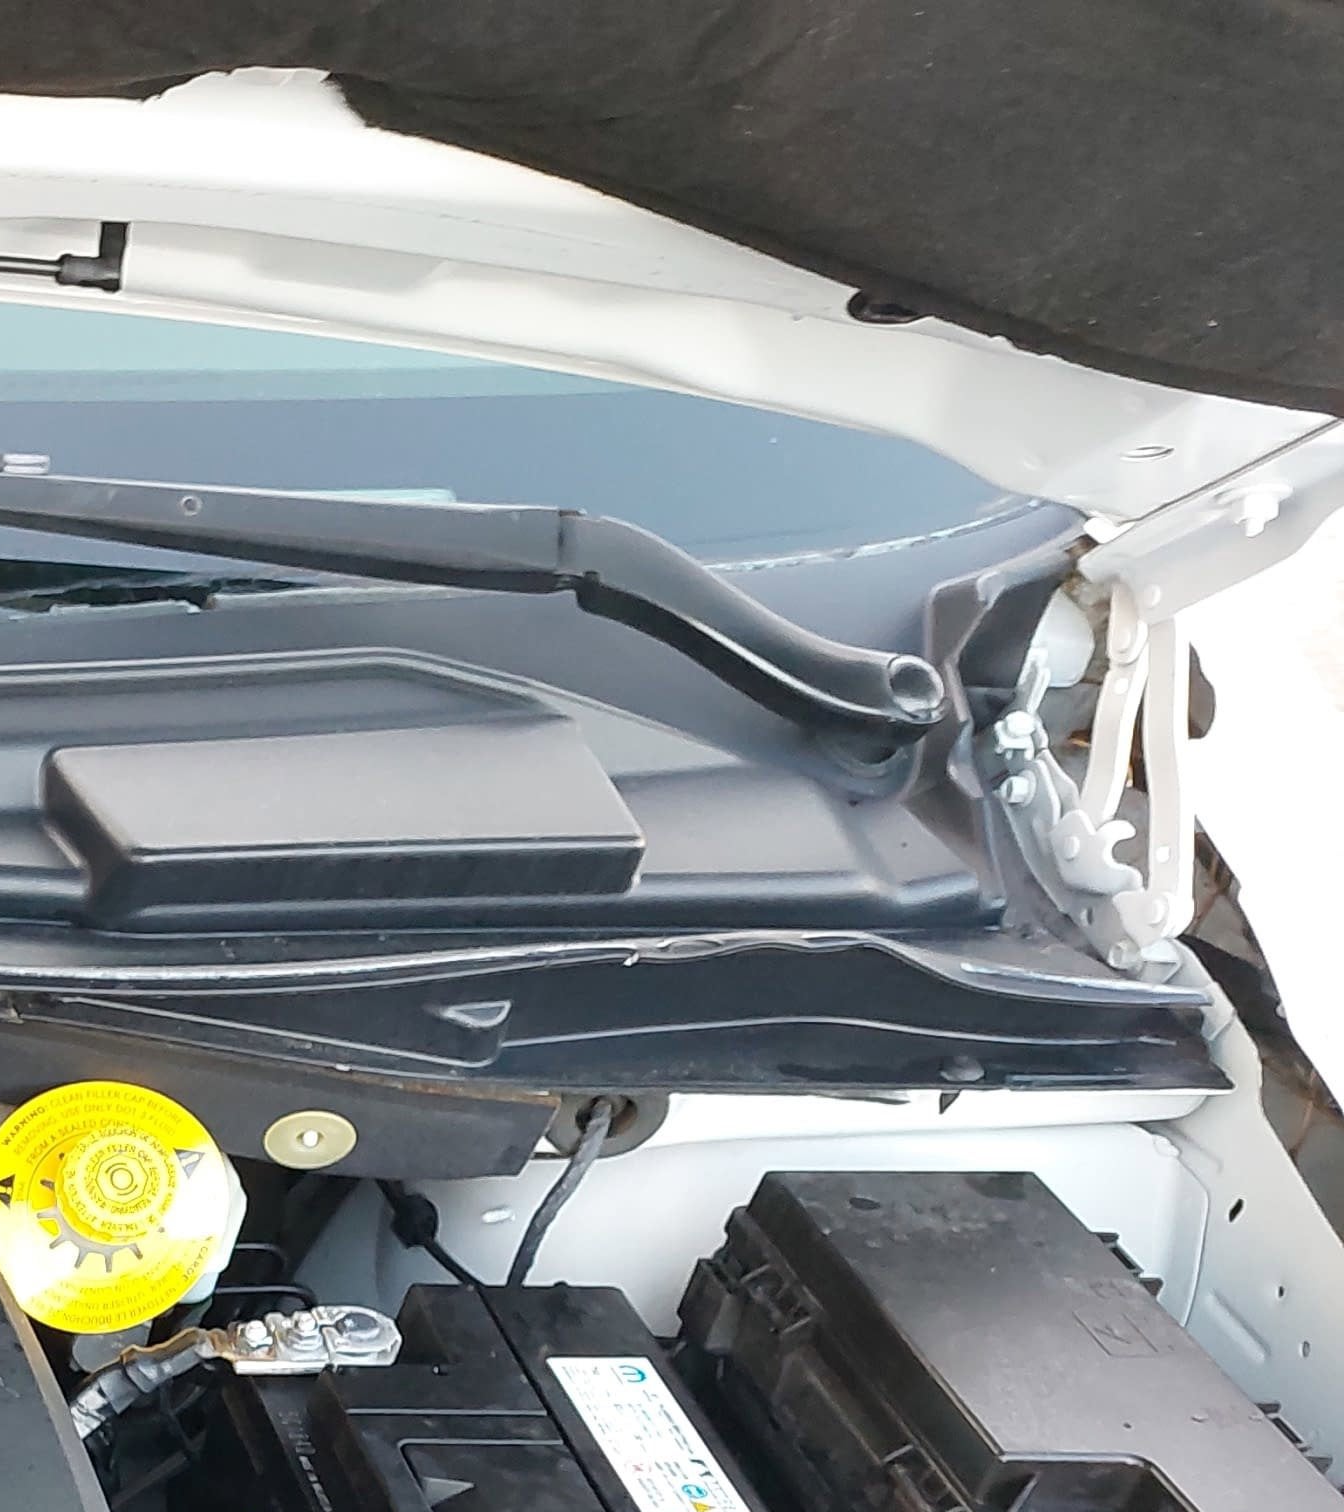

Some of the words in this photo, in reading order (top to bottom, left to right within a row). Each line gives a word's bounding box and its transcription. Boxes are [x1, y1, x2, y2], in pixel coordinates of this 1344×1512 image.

[48, 1090, 83, 1110] CLEAN
[85, 1088, 121, 1099] FILLER
[122, 1090, 147, 1106] CAP
[58, 1104, 80, 1120] USE
[82, 1101, 112, 1113] ONLY
[114, 1102, 137, 1117] DOT
[24, 1137, 50, 1166] FROM
[47, 1131, 58, 1143] A
[56, 1116, 96, 1138] SEALED
